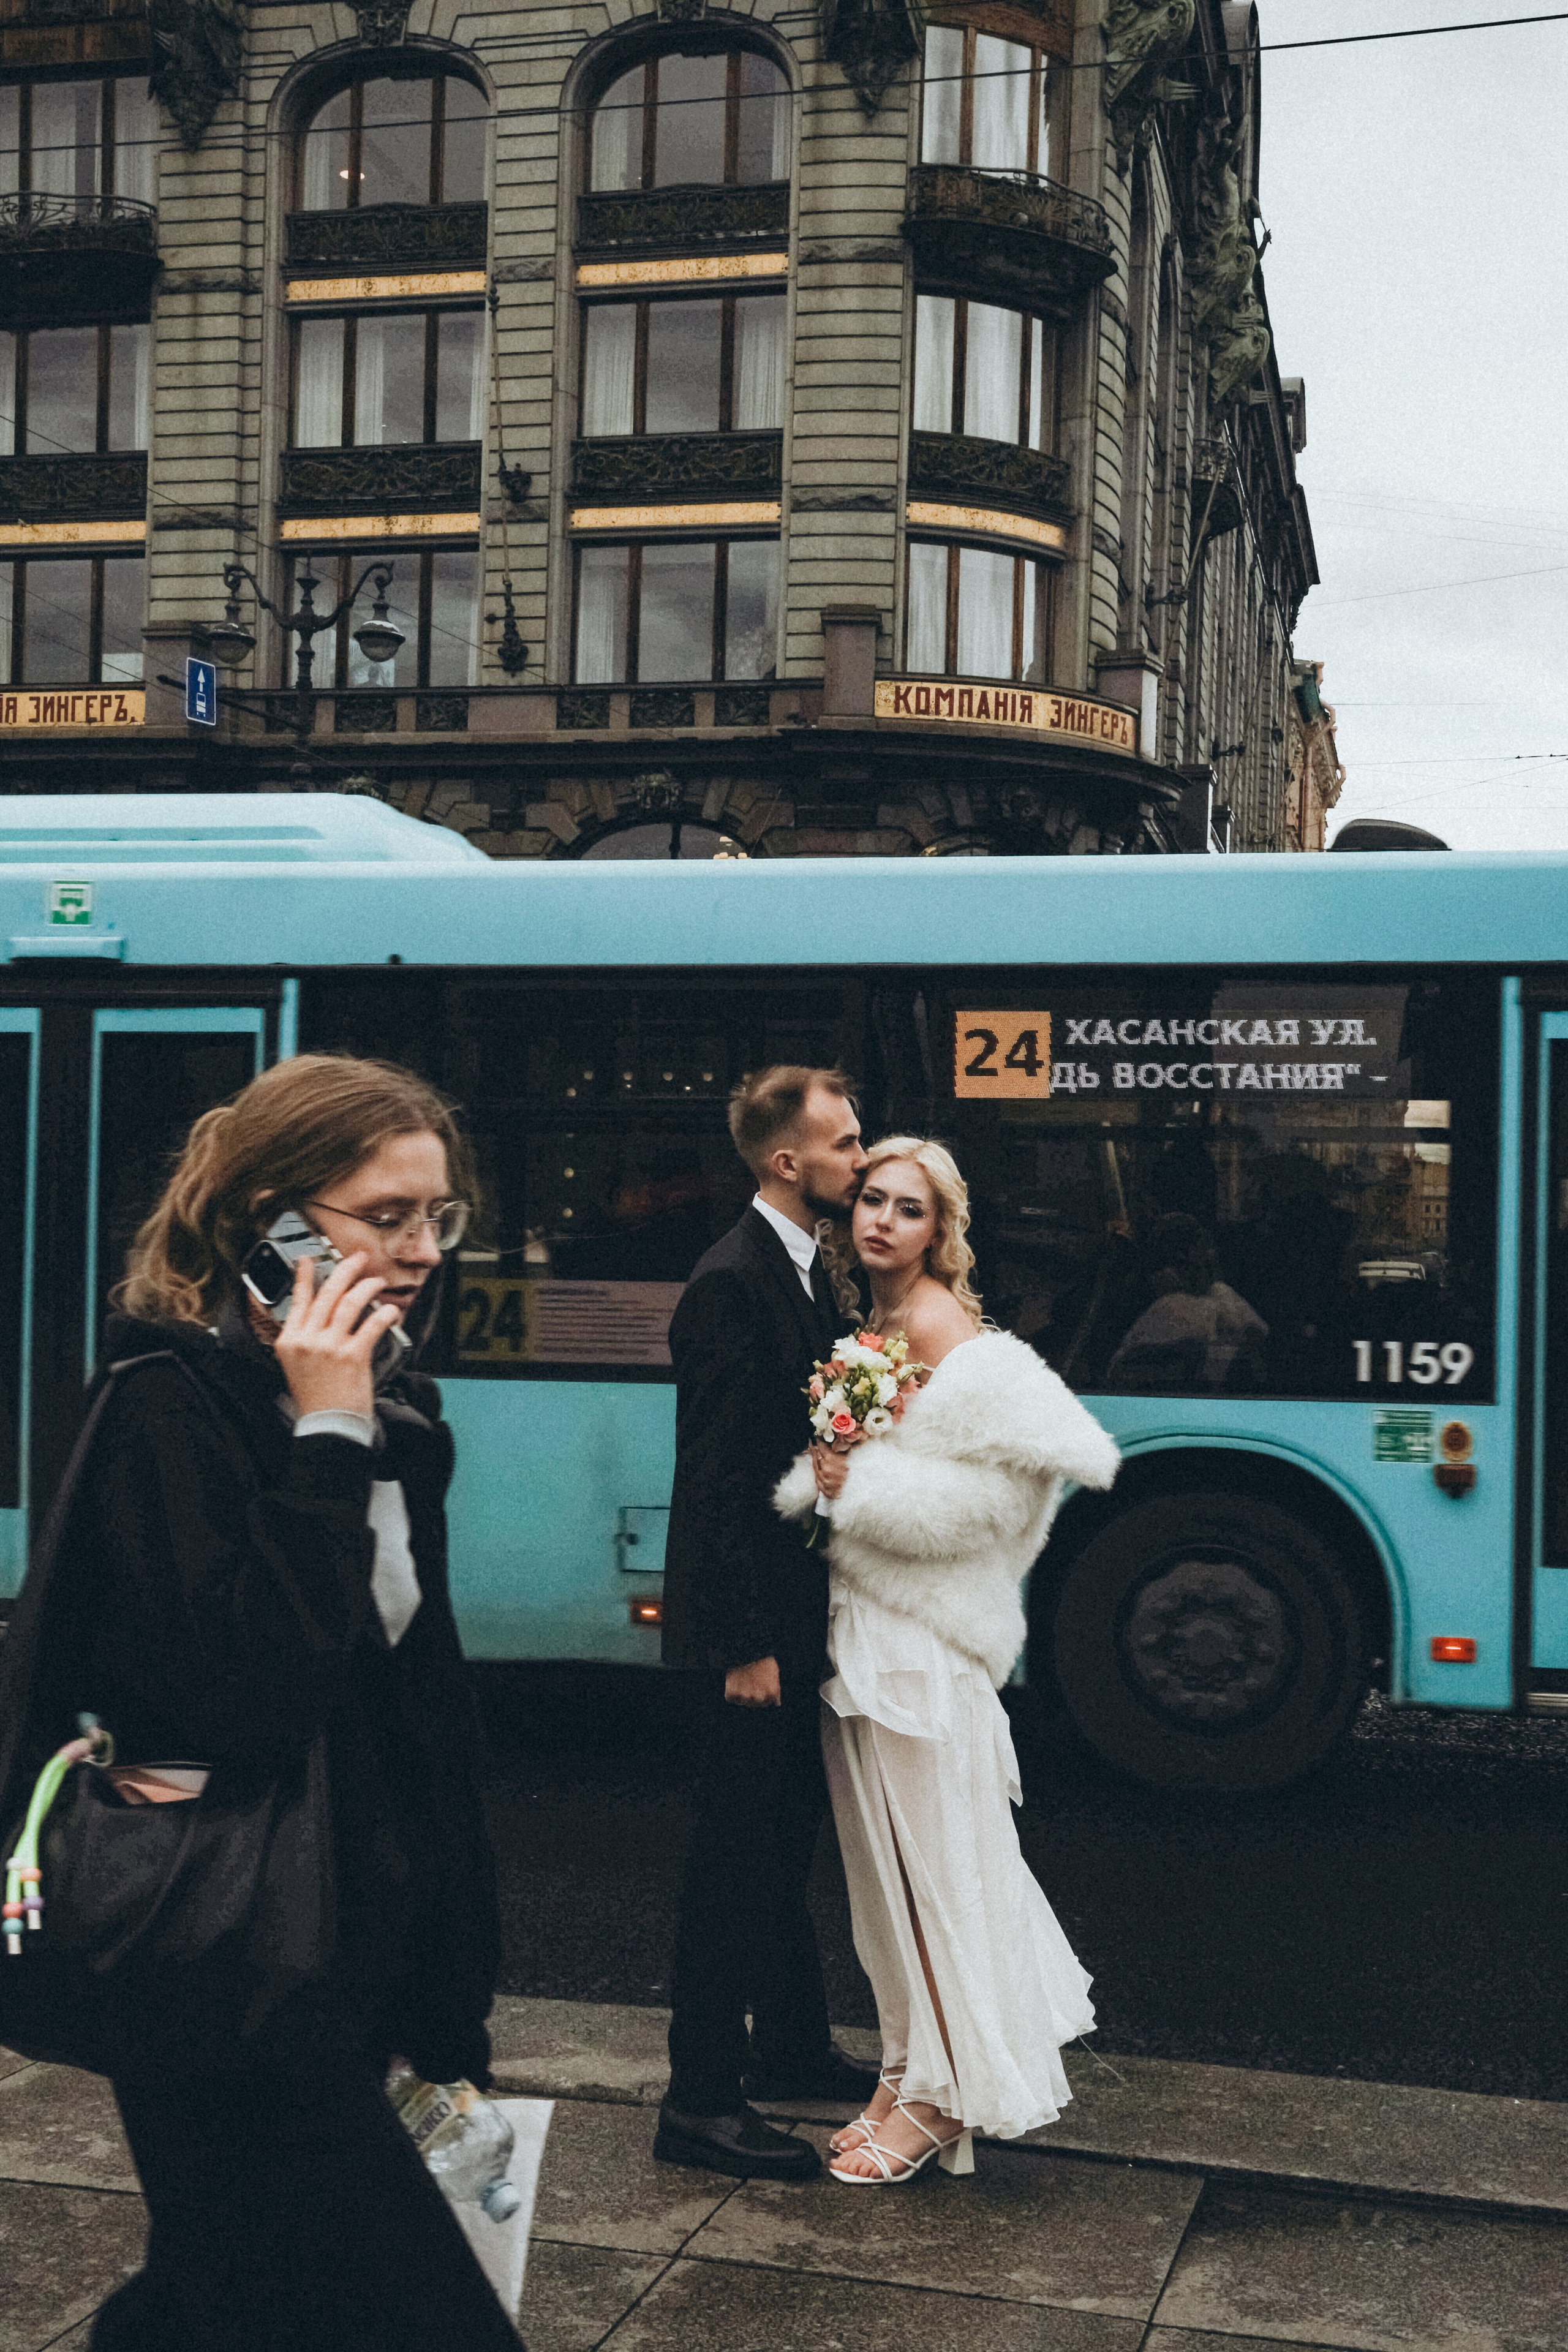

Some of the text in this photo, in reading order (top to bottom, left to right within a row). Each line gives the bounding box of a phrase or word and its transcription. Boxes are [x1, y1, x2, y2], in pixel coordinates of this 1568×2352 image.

[894, 685, 1128, 745] КОМПАНІЯ ЗИНГЕРЪ
[964, 1028, 1044, 1077] 24
[1065, 1019, 1300, 1045] ХАСАНСКАЯ
[1112, 1063, 1361, 1090] ВОССТАНИЯ"
[458, 1287, 527, 1353] 24
[1352, 1340, 1475, 1384] 1159
